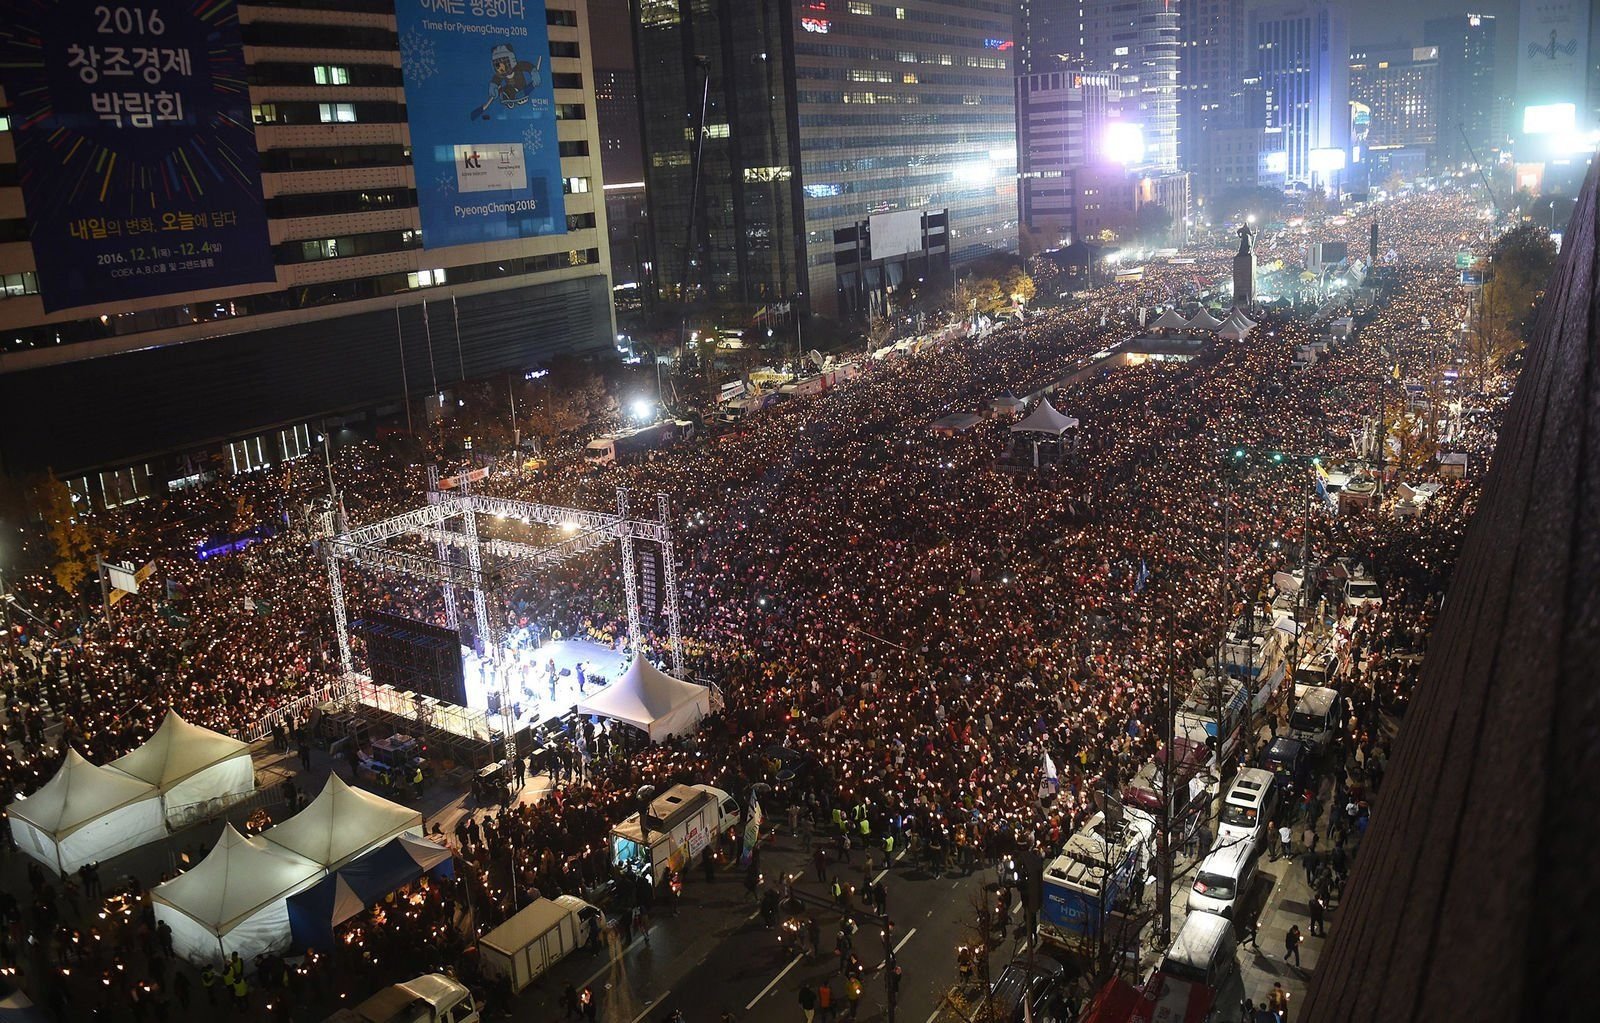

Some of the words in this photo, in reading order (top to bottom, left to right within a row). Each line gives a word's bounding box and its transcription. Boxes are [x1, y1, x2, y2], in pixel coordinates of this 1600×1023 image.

[421, 0, 465, 15] 이제는
[469, 0, 526, 20] 평창이다
[94, 6, 166, 36] 2016
[422, 19, 443, 31] Time
[444, 21, 456, 31] for
[456, 22, 510, 37] PyeongChang
[510, 27, 528, 36] 2018
[67, 44, 193, 84] 창조경제
[91, 90, 184, 129] 박람회
[464, 151, 481, 169] kt
[454, 202, 515, 217] PyeongChang
[516, 200, 536, 211] 2018
[69, 217, 121, 240] 내일의
[161, 211, 208, 233] 오늘에
[211, 210, 237, 229] 담다
[96, 252, 128, 266] 2016.
[111, 267, 133, 279] COEX
